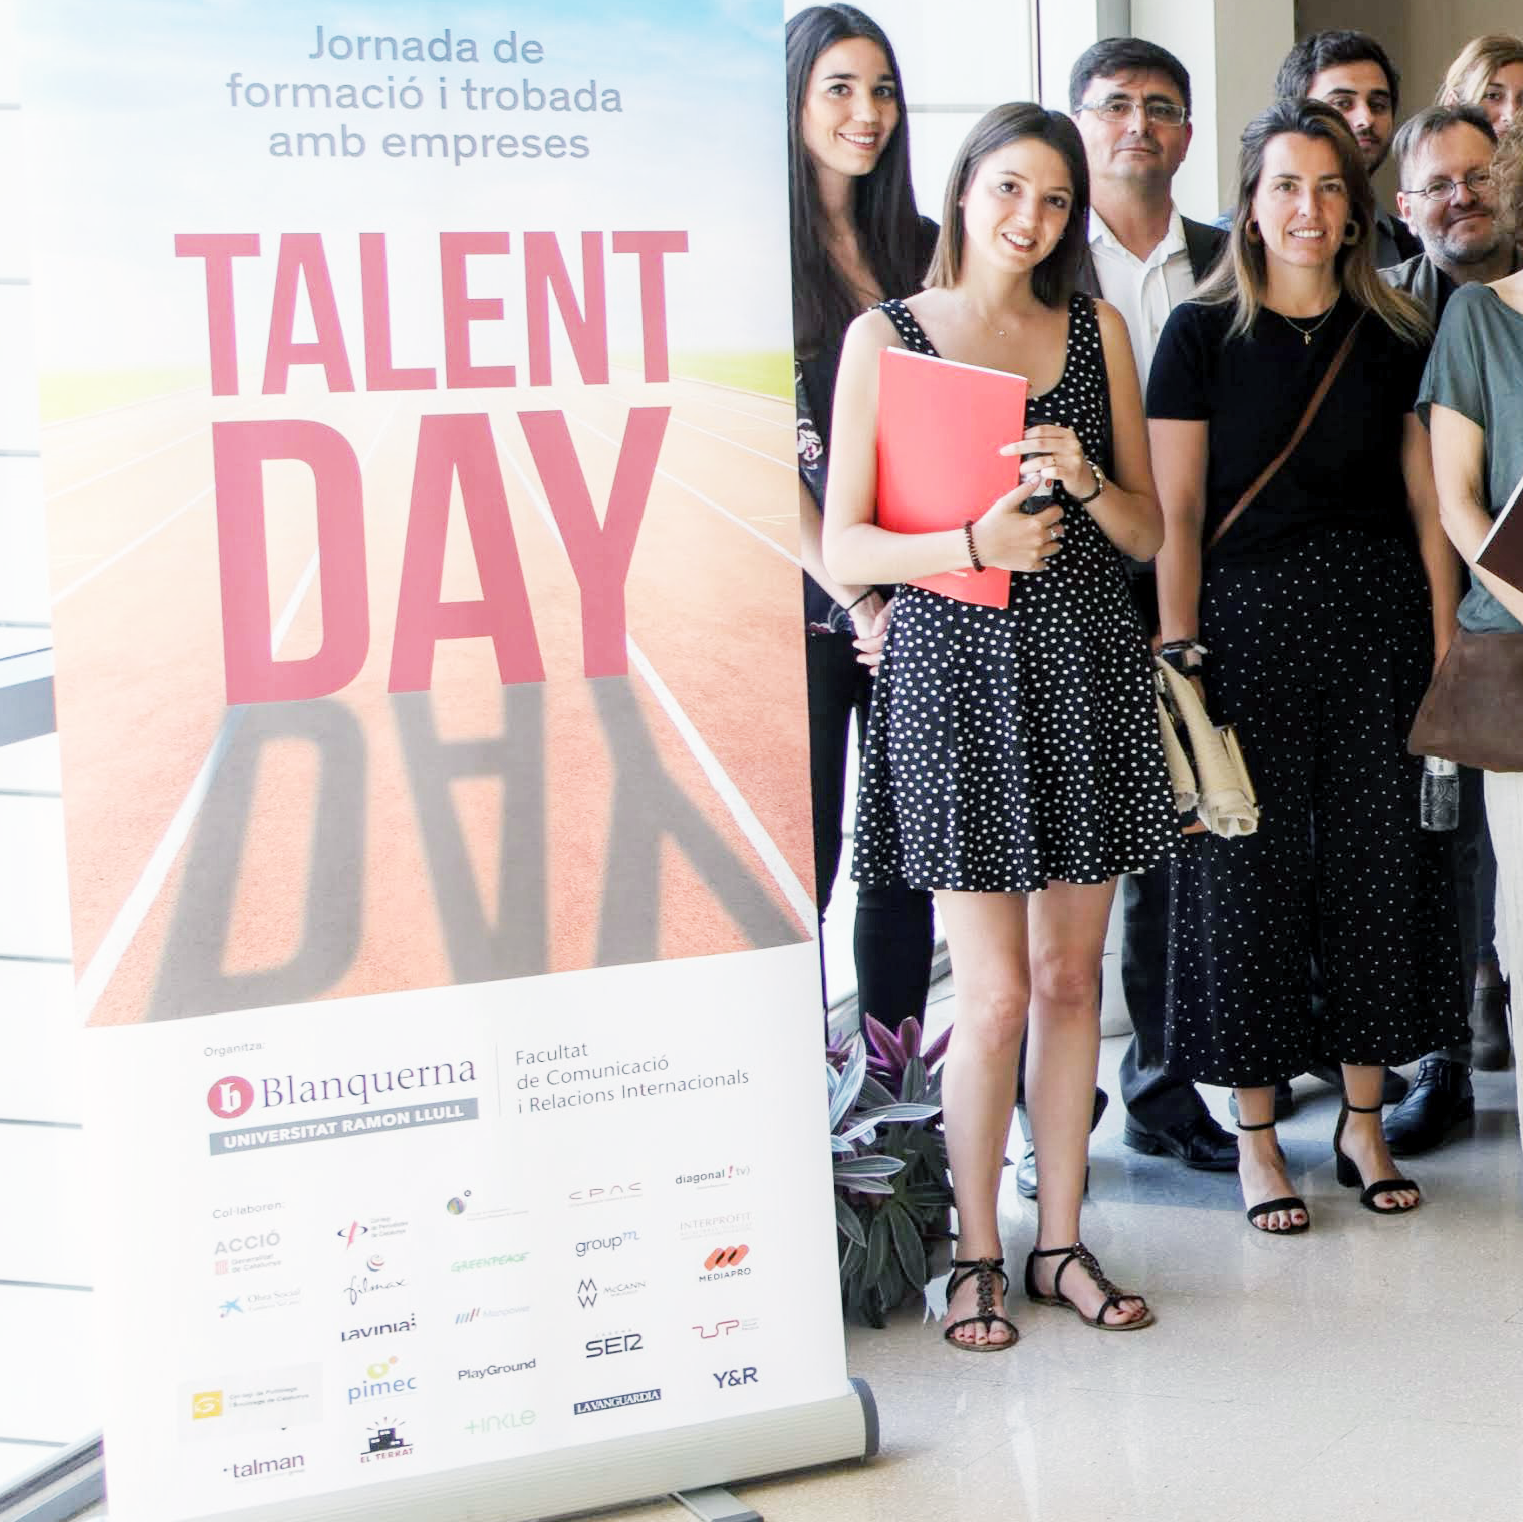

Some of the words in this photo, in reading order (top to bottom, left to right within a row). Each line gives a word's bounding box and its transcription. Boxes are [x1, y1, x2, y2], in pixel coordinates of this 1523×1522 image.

[309, 24, 480, 64] Jornada
[492, 30, 545, 64] de
[226, 73, 424, 111] formació
[438, 76, 449, 110] i
[460, 78, 624, 114] trobada
[269, 125, 366, 159] amb
[381, 132, 590, 167] empreses
[174, 230, 689, 397] TALENT
[211, 406, 672, 706] DAY
[203, 1042, 266, 1057] Organitza:
[516, 1043, 588, 1065] Facultat
[261, 1059, 477, 1108] Blanquerna
[517, 1075, 540, 1090] de
[546, 1054, 669, 1086] Comunicació
[530, 1089, 615, 1112] Relacions
[622, 1069, 749, 1099] Internacionals
[223, 1122, 338, 1149] UNIVERSITAT
[342, 1113, 410, 1133] RAMON
[415, 1105, 464, 1123] LLULL
[214, 1230, 281, 1255] ACCIÓ
[451, 1252, 530, 1273] GREENPEACE
[699, 1267, 751, 1282] MEDIAPRO
[344, 1275, 407, 1305] filmax
[585, 1333, 644, 1358] SER
[458, 1358, 536, 1380] PlayGround
[713, 1367, 759, 1389] Y&R
[348, 1377, 417, 1405] pimec
[234, 1455, 305, 1478] talman
[361, 1455, 371, 1463] EL
[375, 1448, 414, 1461] TERRAT
